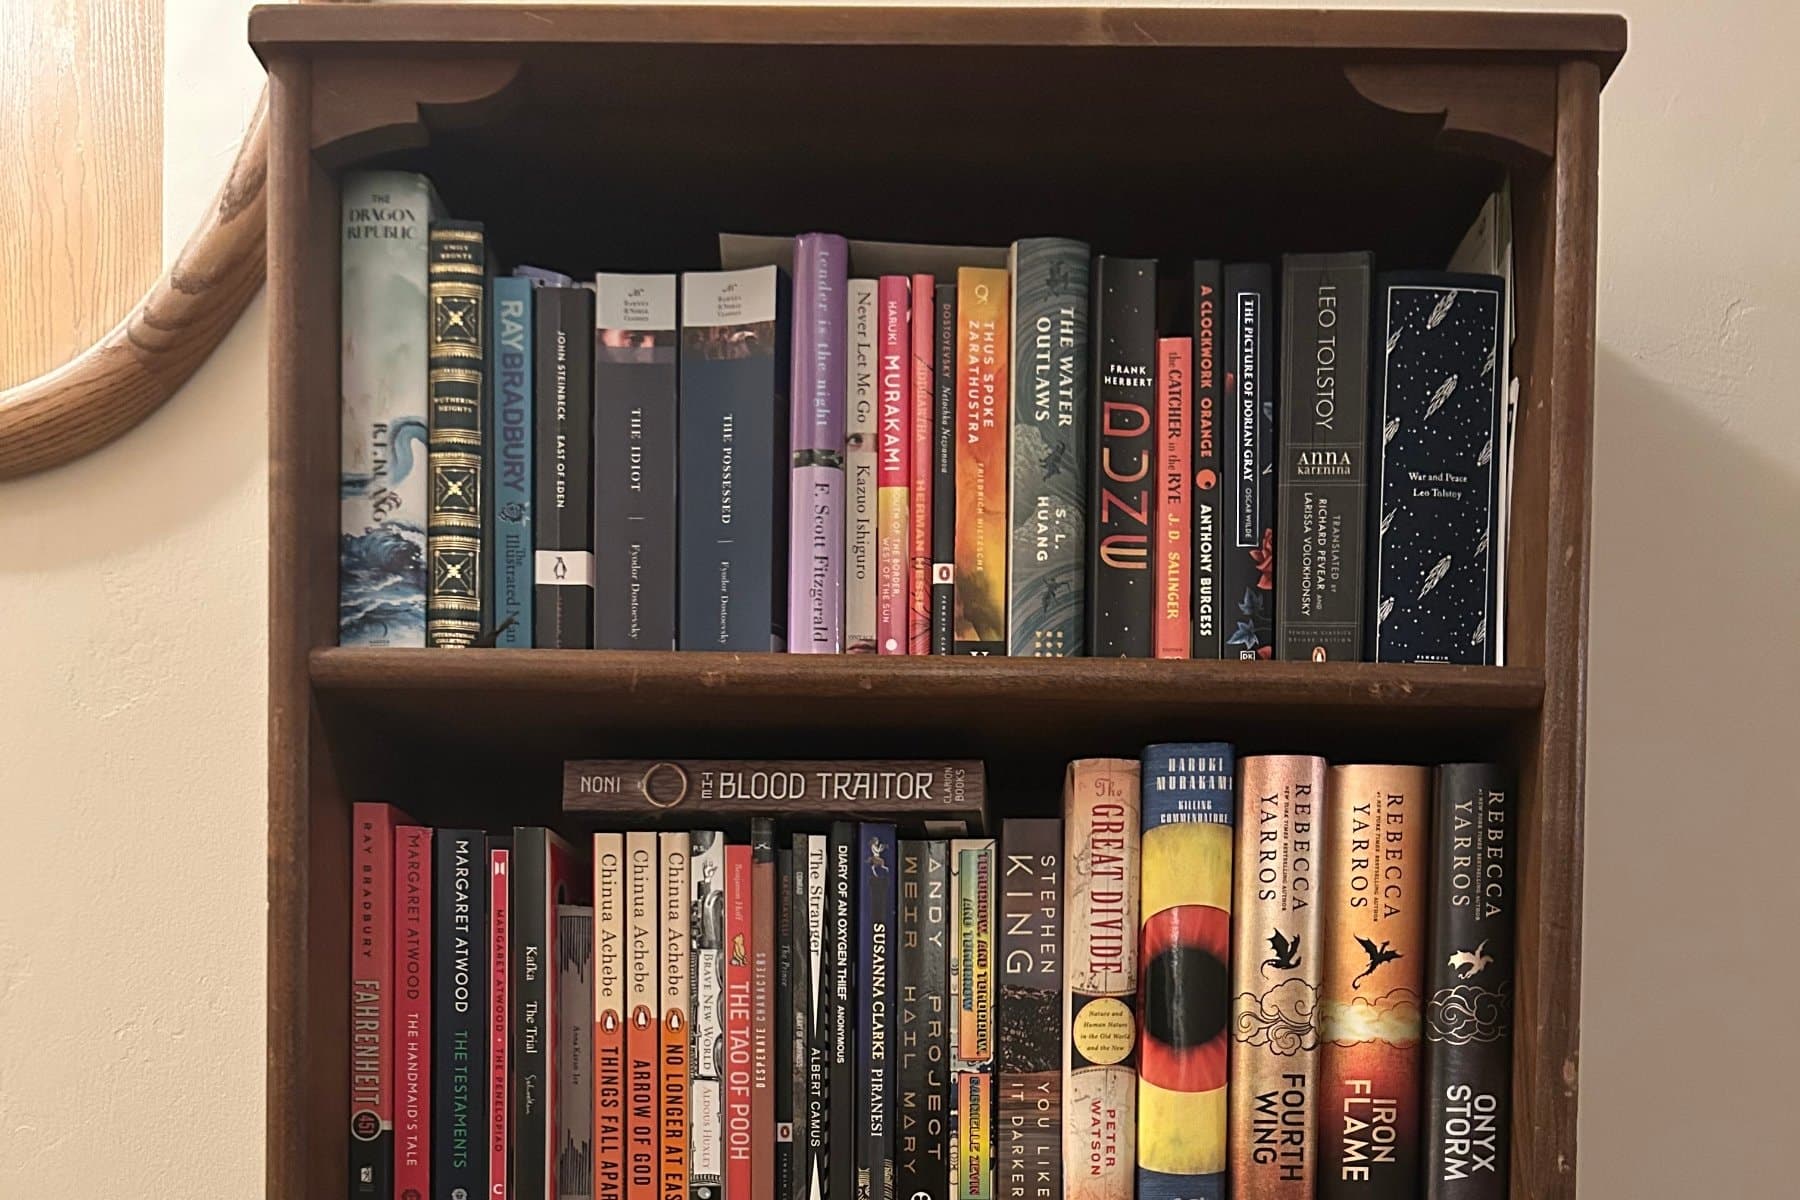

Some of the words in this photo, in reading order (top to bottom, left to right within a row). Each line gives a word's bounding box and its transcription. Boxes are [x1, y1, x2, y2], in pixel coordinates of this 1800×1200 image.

[350, 207, 415, 221] DRAGON
[371, 192, 391, 203] THE
[347, 226, 416, 239] REPUBLIC
[501, 300, 524, 350] RAY
[887, 301, 897, 345] HARUKI
[1060, 306, 1075, 348] THE
[1244, 299, 1254, 324] THE
[1318, 287, 1336, 328] LEO
[557, 331, 567, 361] JOHN
[982, 321, 994, 364] THUS
[1244, 327, 1254, 378] PICTURE
[557, 365, 567, 421] STEINBECK
[967, 320, 980, 444] ZARATHUSTRA
[1036, 317, 1051, 421] OUTLAWS
[1058, 355, 1074, 427] WATER
[1104, 376, 1153, 387] HERBERT
[1110, 363, 1147, 375] FRANK
[1244, 381, 1254, 396] OF
[1315, 336, 1336, 430] TOLSTOY
[502, 352, 525, 492] BRADBURY
[884, 355, 901, 471] MURAKAMI
[981, 371, 994, 428] SPOKE
[1243, 399, 1254, 447] DORIAN
[557, 435, 567, 461] EAST
[557, 463, 567, 477] OF
[1243, 449, 1254, 482] GRAY
[557, 480, 567, 508] EDEN
[814, 483, 830, 496] F.
[856, 465, 871, 513] Kazuo
[1409, 472, 1425, 483] War
[1427, 472, 1443, 482] and
[1446, 473, 1467, 484] Peace
[1413, 488, 1430, 497] Leo
[1432, 488, 1462, 500] Tolstoy
[814, 504, 830, 548] Scott
[851, 518, 871, 579] Ishiguro
[1200, 504, 1212, 572] ANTHONY
[811, 555, 829, 642] Fitzgerald
[1200, 578, 1212, 636] BURGESS
[581, 776, 620, 792] NONI
[702, 772, 713, 799] THE
[720, 772, 805, 799] BLOOD
[816, 772, 933, 800] TRAITOR
[838, 845, 848, 878] DIARY
[1259, 793, 1279, 901] YARROS
[1292, 783, 1312, 912] REBECCA
[1452, 800, 1473, 907] YARROS
[1485, 791, 1504, 918] REBECCA
[455, 840, 469, 932] MARGARET
[601, 853, 617, 921] Chinua
[838, 882, 848, 898] OF
[838, 900, 848, 916] AN
[1006, 855, 1033, 974] KING
[1041, 855, 1056, 973] STEPHEN
[526, 946, 538, 981] Kafka
[601, 929, 617, 997] Achebe
[837, 918, 847, 966] OXYGEN
[872, 923, 885, 997] SUSANNA
[454, 937, 469, 1012] ATWOOD
[836, 968, 847, 1000] THIEF
[526, 1001, 537, 1024] The
[729, 981, 750, 1020] THE
[408, 1013, 418, 1037] THE
[454, 1031, 468, 1061] THE
[526, 1027, 537, 1053] Trial
[729, 1029, 750, 1063] TAO
[836, 1005, 845, 1063] ANONYMOUS
[871, 1001, 884, 1060] CLARKE
[407, 1042, 418, 1130] HANDMAID'S
[601, 1047, 619, 1107] THINGS
[729, 1071, 750, 1096] OF
[811, 1048, 821, 1095] ALBERT
[453, 1066, 467, 1168] TESTAMENTS
[810, 1101, 821, 1147] CAMUS
[870, 1068, 882, 1137] PIRANESI
[407, 1135, 418, 1166] TALE
[601, 1116, 619, 1153] FALL
[729, 1103, 750, 1160] POOH
[1091, 1100, 1102, 1176] WATSON
[1105, 1109, 1116, 1167] PETER
[1252, 1090, 1279, 1165] WING
[1279, 1073, 1305, 1181] FOURTH
[1341, 1079, 1372, 1181] FLAME
[1371, 1099, 1397, 1162] IRON
[1443, 1084, 1472, 1181] STORM
[1471, 1094, 1497, 1172] ONYX
